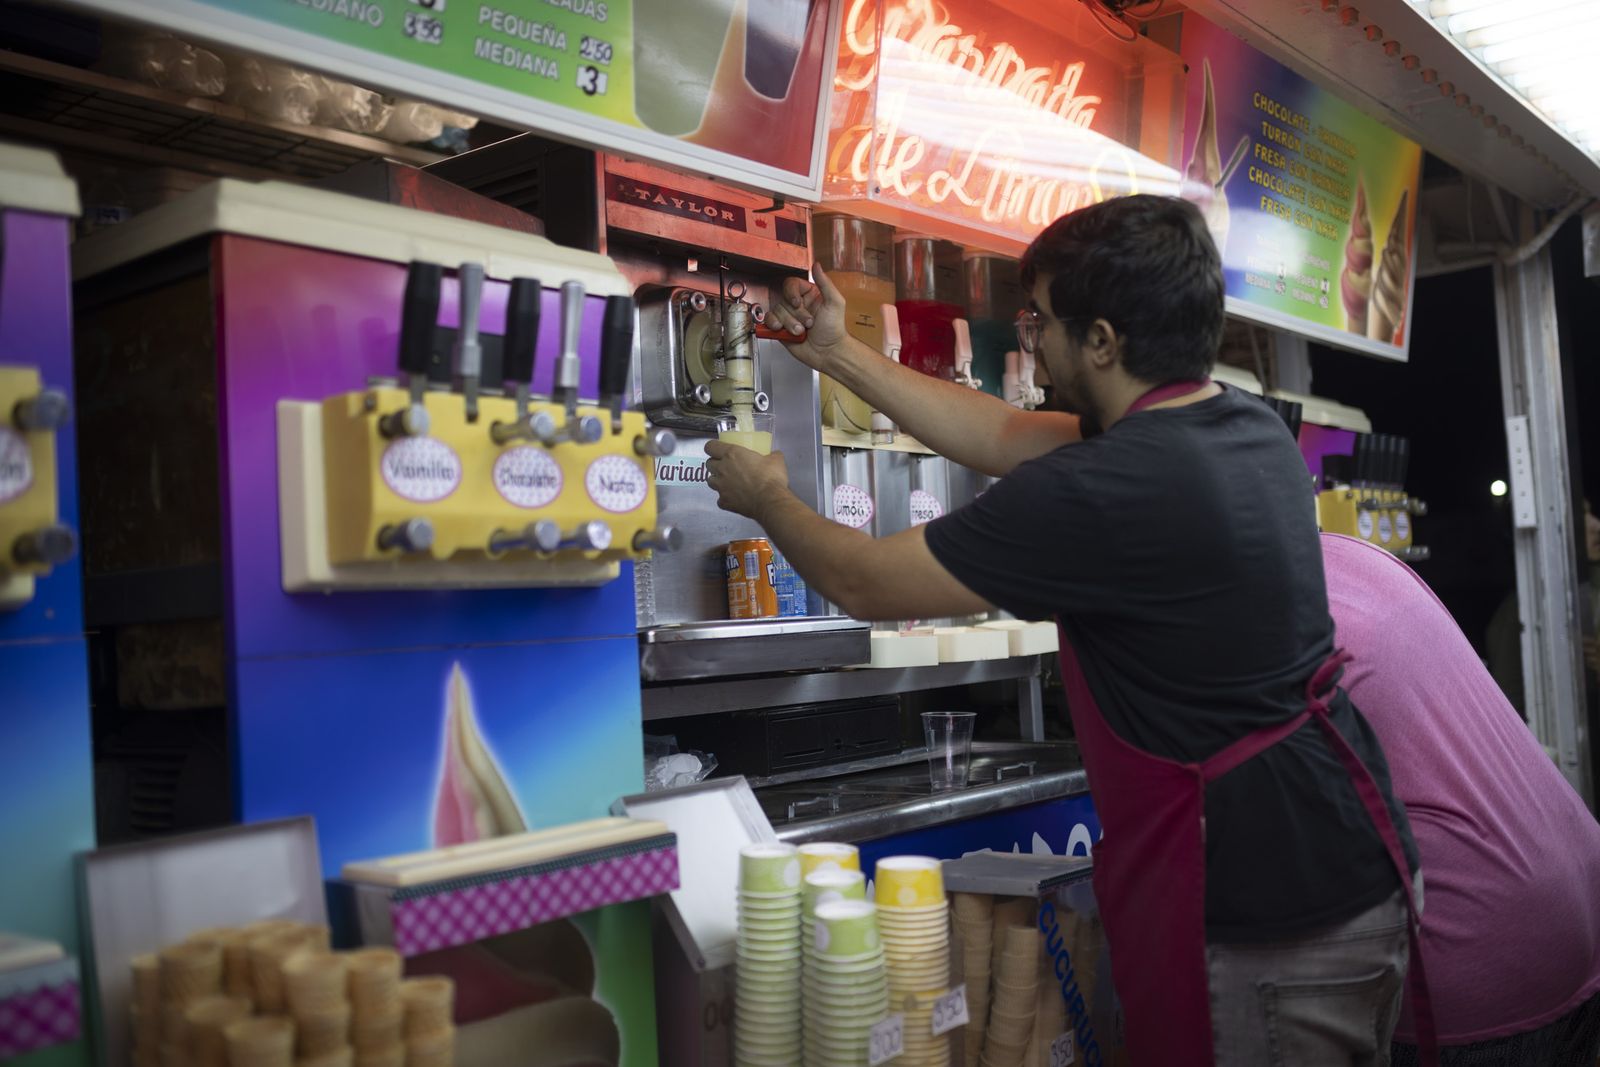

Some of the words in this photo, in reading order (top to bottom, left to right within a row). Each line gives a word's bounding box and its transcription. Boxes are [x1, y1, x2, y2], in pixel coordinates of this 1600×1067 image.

[478, 5, 567, 51] PEQUEÑA
[474, 37, 559, 80] MEDIANA
[582, 65, 599, 96] 3
[1253, 91, 1310, 136] CHOCOLATE
[1254, 142, 1286, 170] FRESA
[1248, 165, 1305, 205] CHOCOLATE
[634, 188, 735, 222] TAYLOR
[1261, 195, 1292, 222] FRESA
[655, 457, 709, 483] Variad
